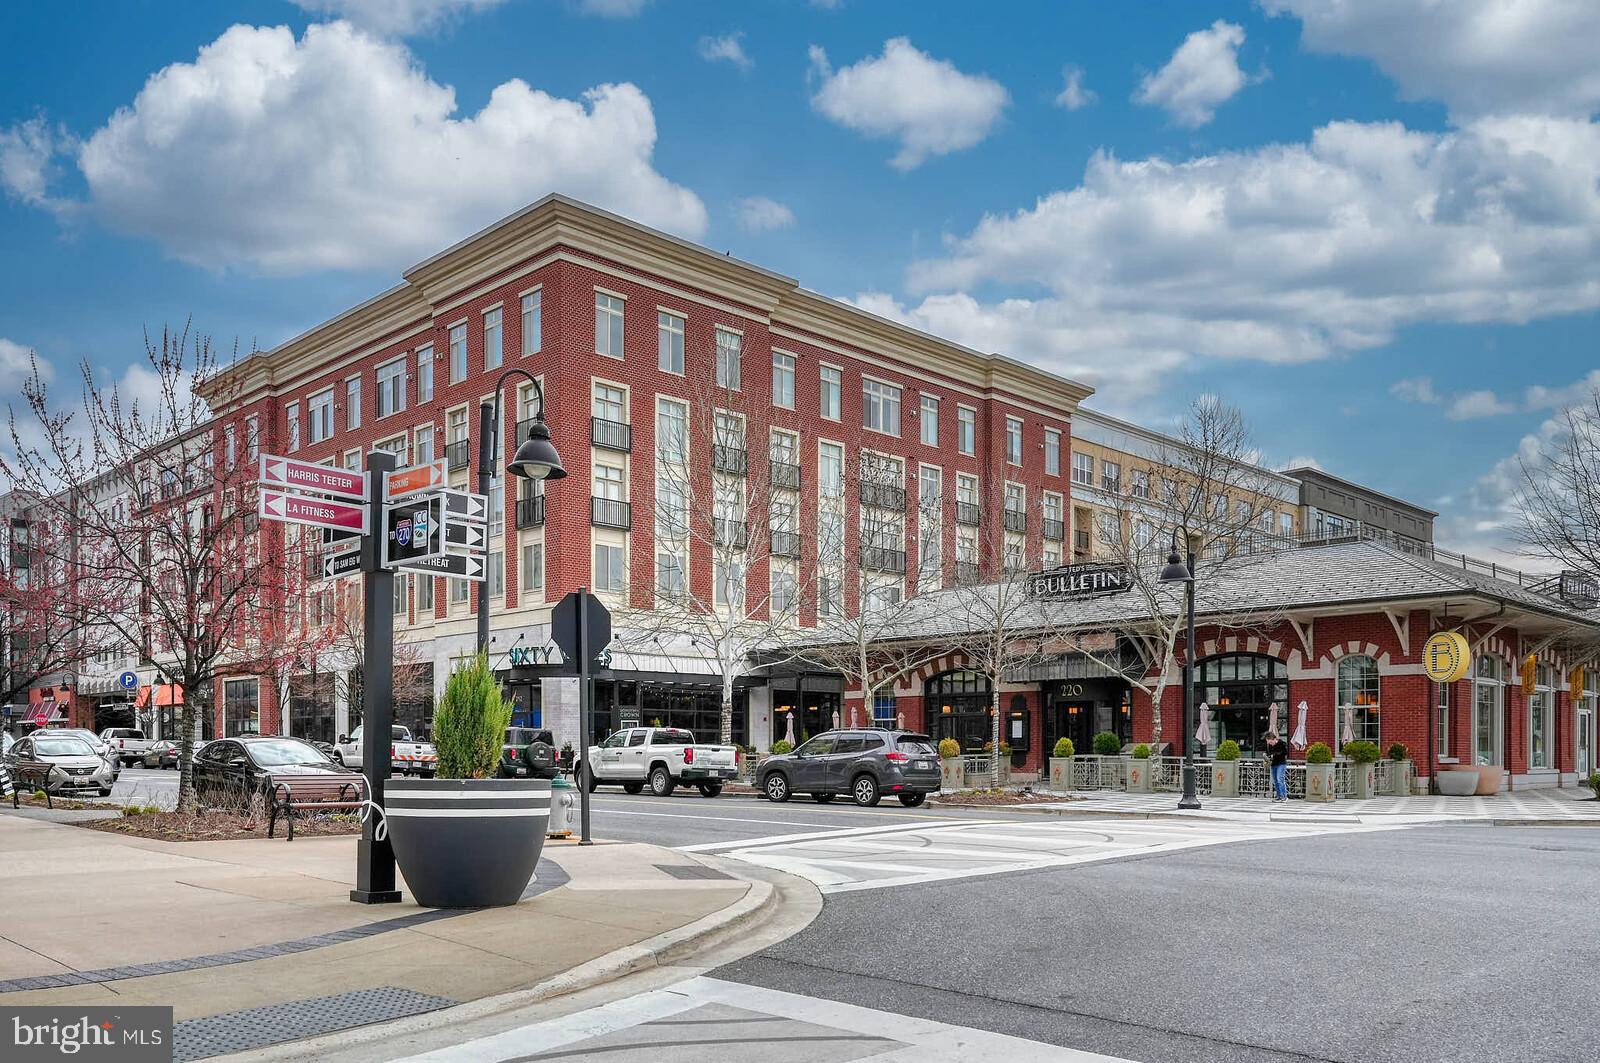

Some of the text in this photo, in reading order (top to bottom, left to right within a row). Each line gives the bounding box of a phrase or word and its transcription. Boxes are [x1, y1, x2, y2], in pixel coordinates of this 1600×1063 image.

[287, 468, 353, 489] HARRIS TEETER
[287, 503, 335, 520] LA FITNESS
[414, 511, 427, 524] ICC
[389, 527, 410, 541] TO 270
[340, 558, 349, 569] SAM
[1035, 571, 1121, 595] BULLETIN
[508, 646, 554, 666] SIXTY
[125, 675, 133, 686] P
[1061, 684, 1083, 697] 220
